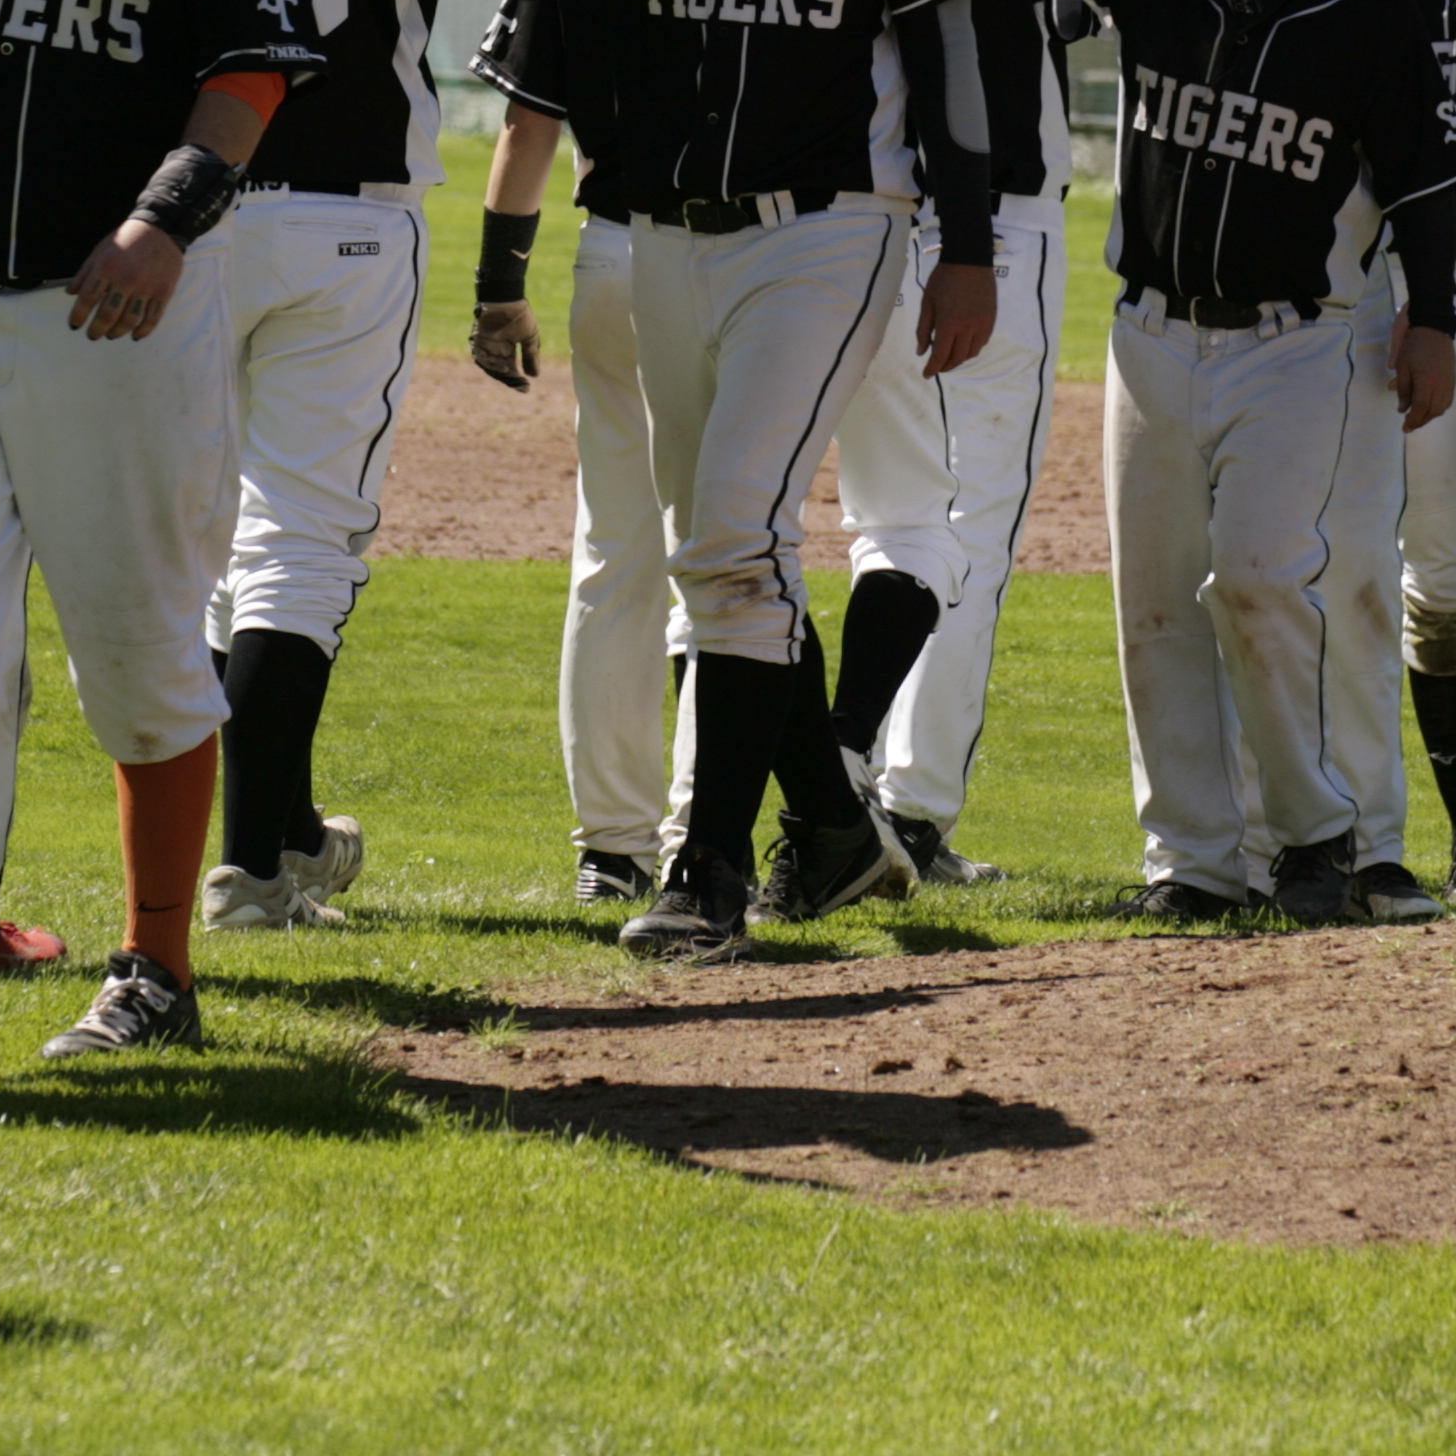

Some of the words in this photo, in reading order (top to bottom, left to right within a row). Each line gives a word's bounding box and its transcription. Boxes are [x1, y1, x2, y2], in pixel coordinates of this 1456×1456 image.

[266, 45, 310, 59] TNKD
[1132, 63, 1334, 183] TIGERS
[339, 243, 380, 256] TNKD
